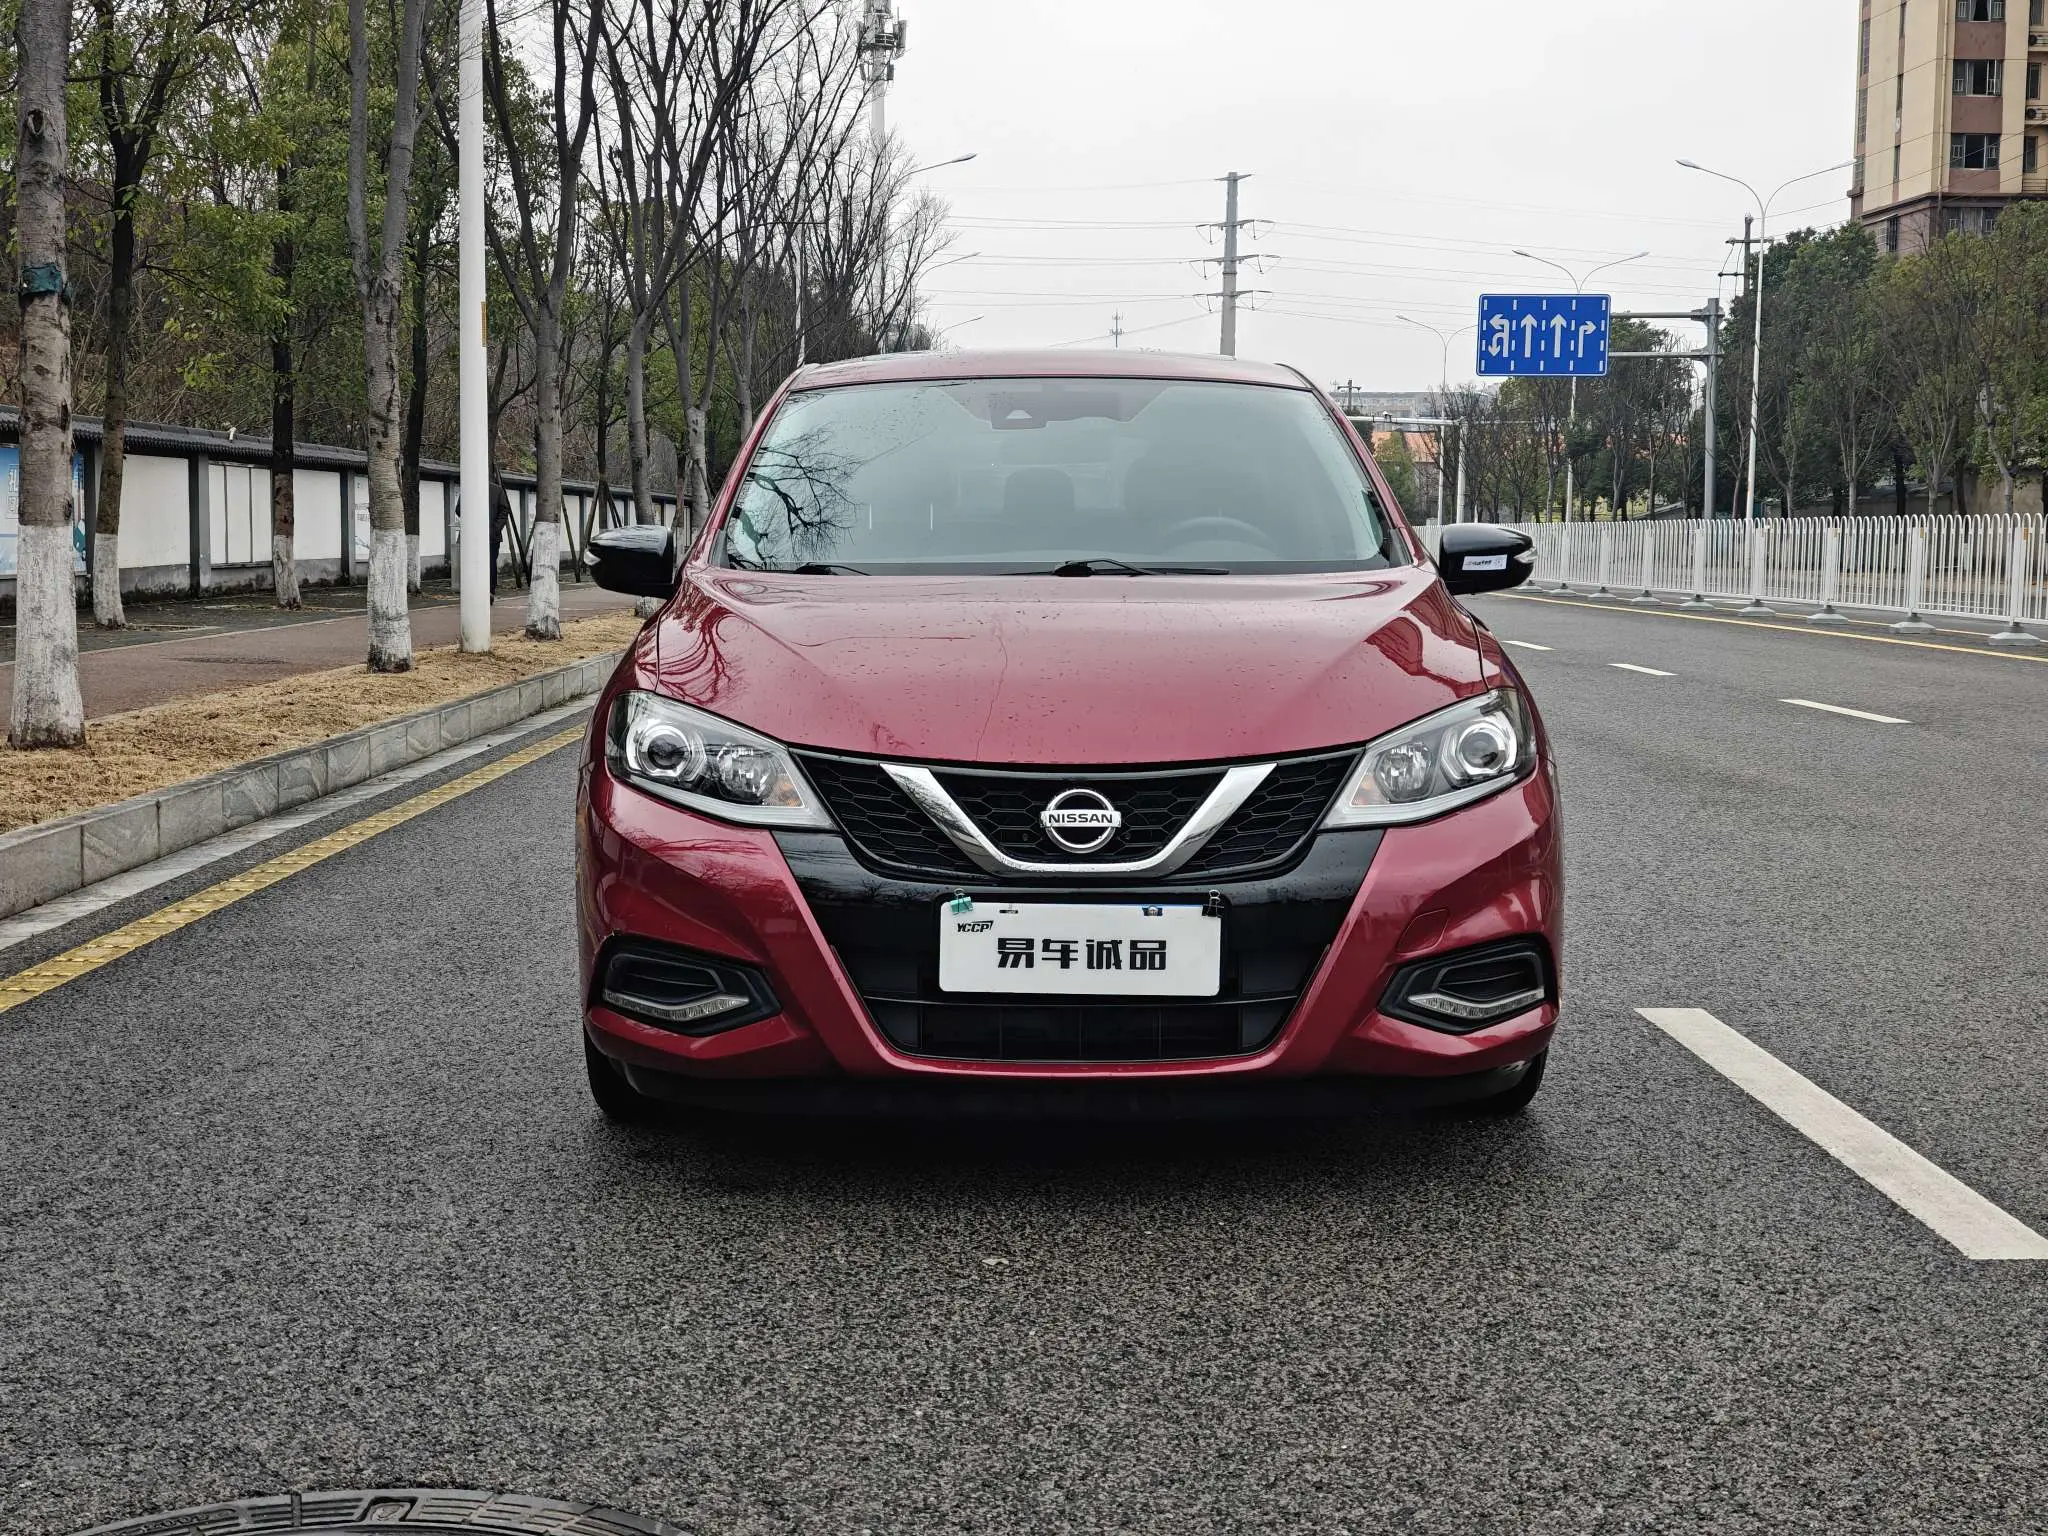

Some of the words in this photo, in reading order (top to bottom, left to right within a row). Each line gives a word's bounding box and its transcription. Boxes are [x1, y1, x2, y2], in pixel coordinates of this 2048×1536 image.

[1048, 813, 1113, 824] NISSAN
[957, 921, 993, 933] YCCP
[997, 937, 1167, 970] 易车诚品
